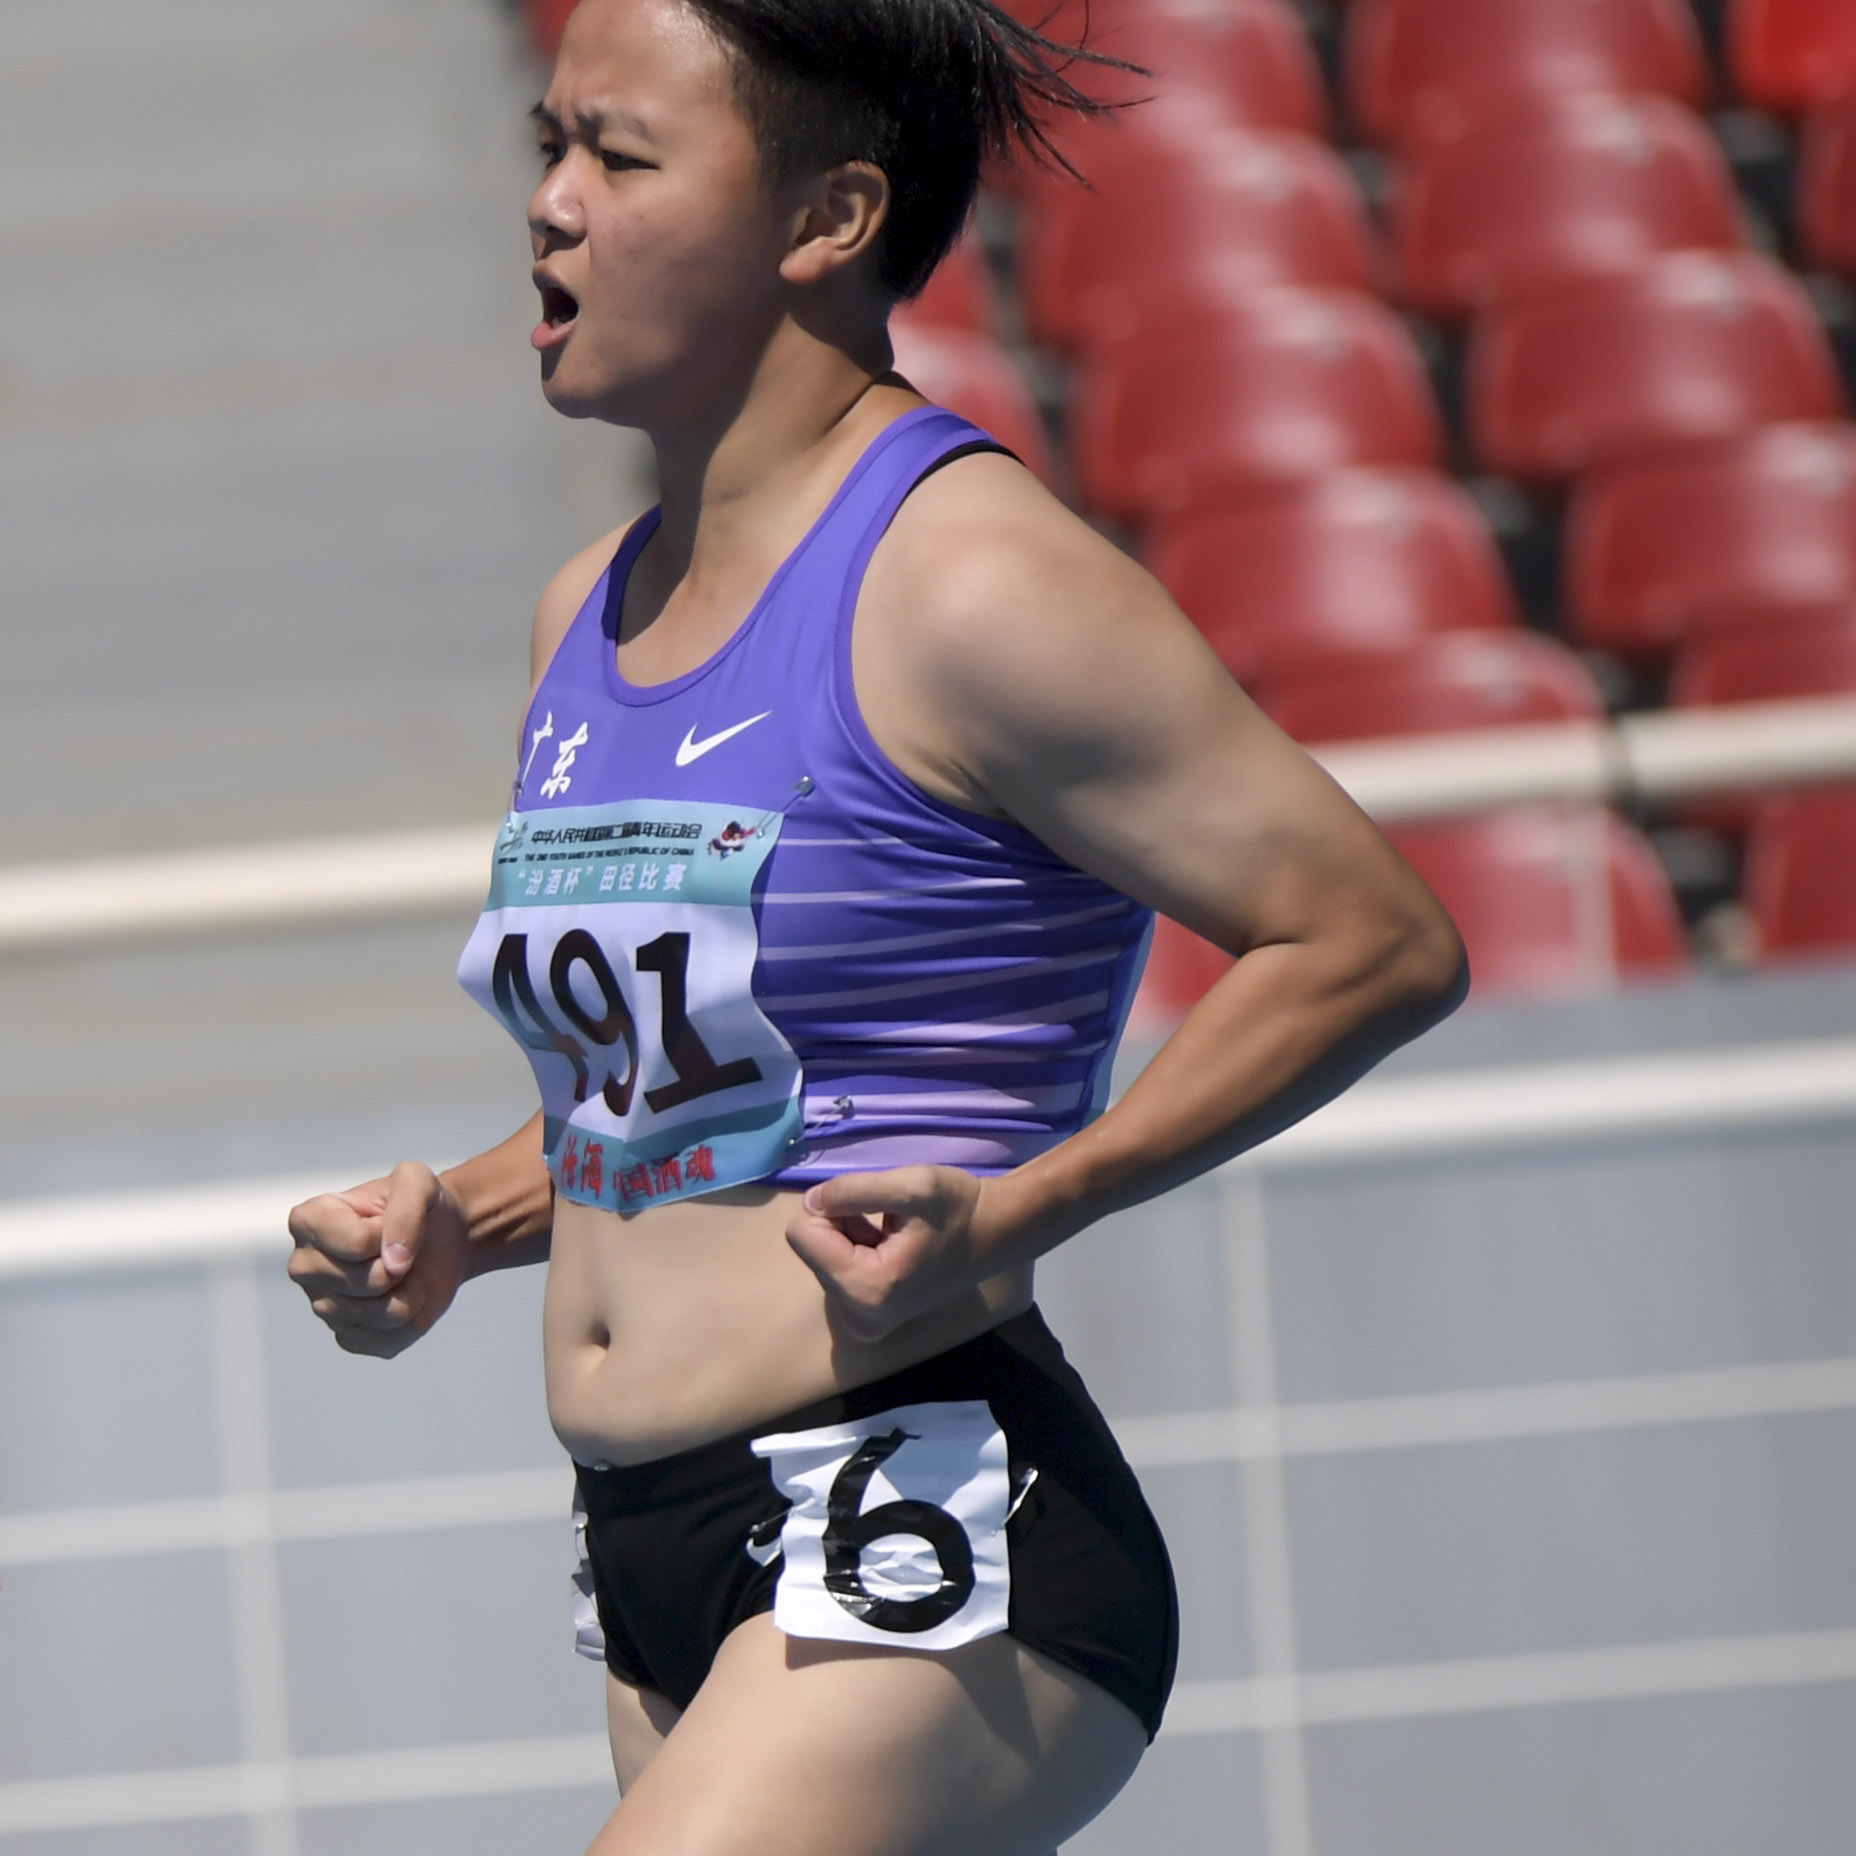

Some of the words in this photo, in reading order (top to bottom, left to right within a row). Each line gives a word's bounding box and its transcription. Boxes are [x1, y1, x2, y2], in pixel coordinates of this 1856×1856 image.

[520, 709, 589, 800] 广东
[599, 863, 687, 891] 田径比赛
[492, 928, 763, 1118] 491
[823, 1427, 976, 1633] 6
